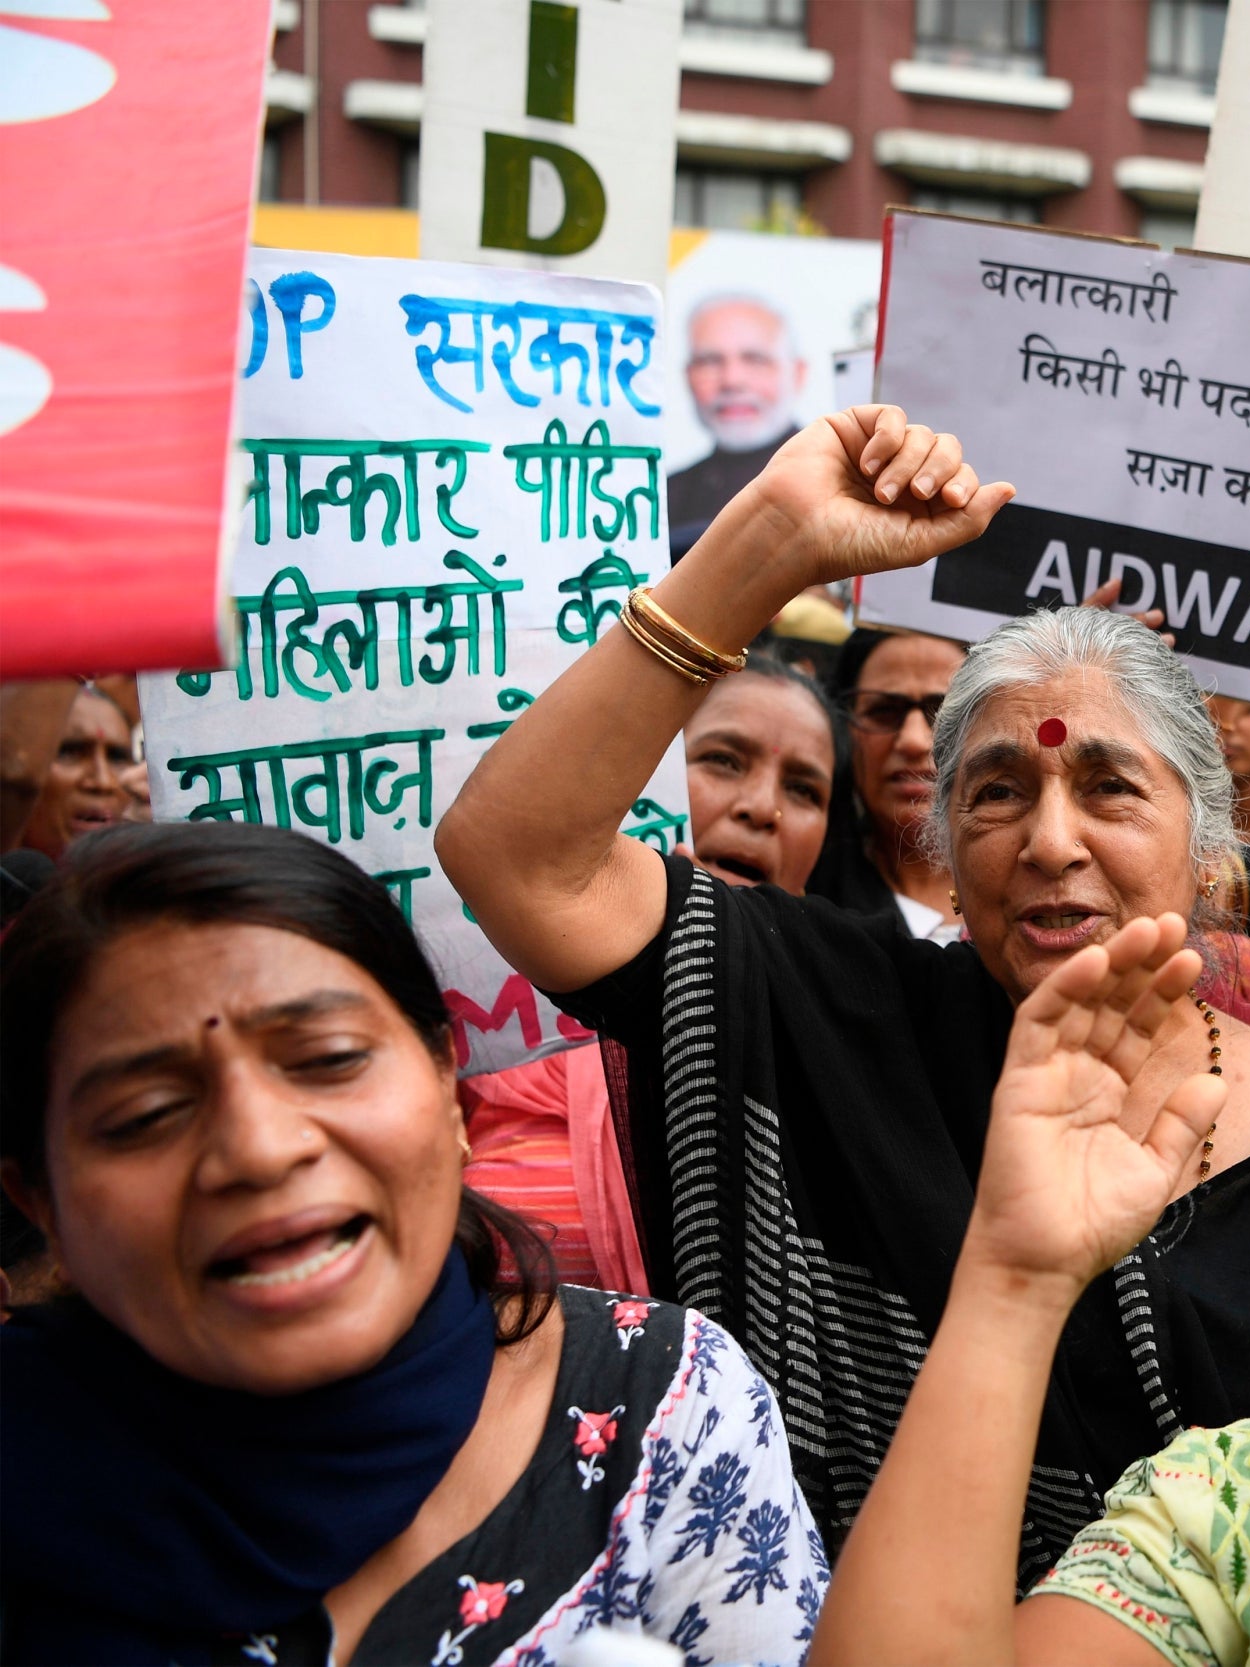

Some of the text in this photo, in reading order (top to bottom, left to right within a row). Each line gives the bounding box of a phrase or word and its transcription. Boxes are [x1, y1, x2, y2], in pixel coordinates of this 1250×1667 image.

[979, 258, 1179, 324] बलात्कारी
[399, 293, 662, 418] सरकार
[1018, 332, 1128, 399] किसी
[1137, 358, 1190, 410] भी
[1125, 447, 1214, 498] सज़ा
